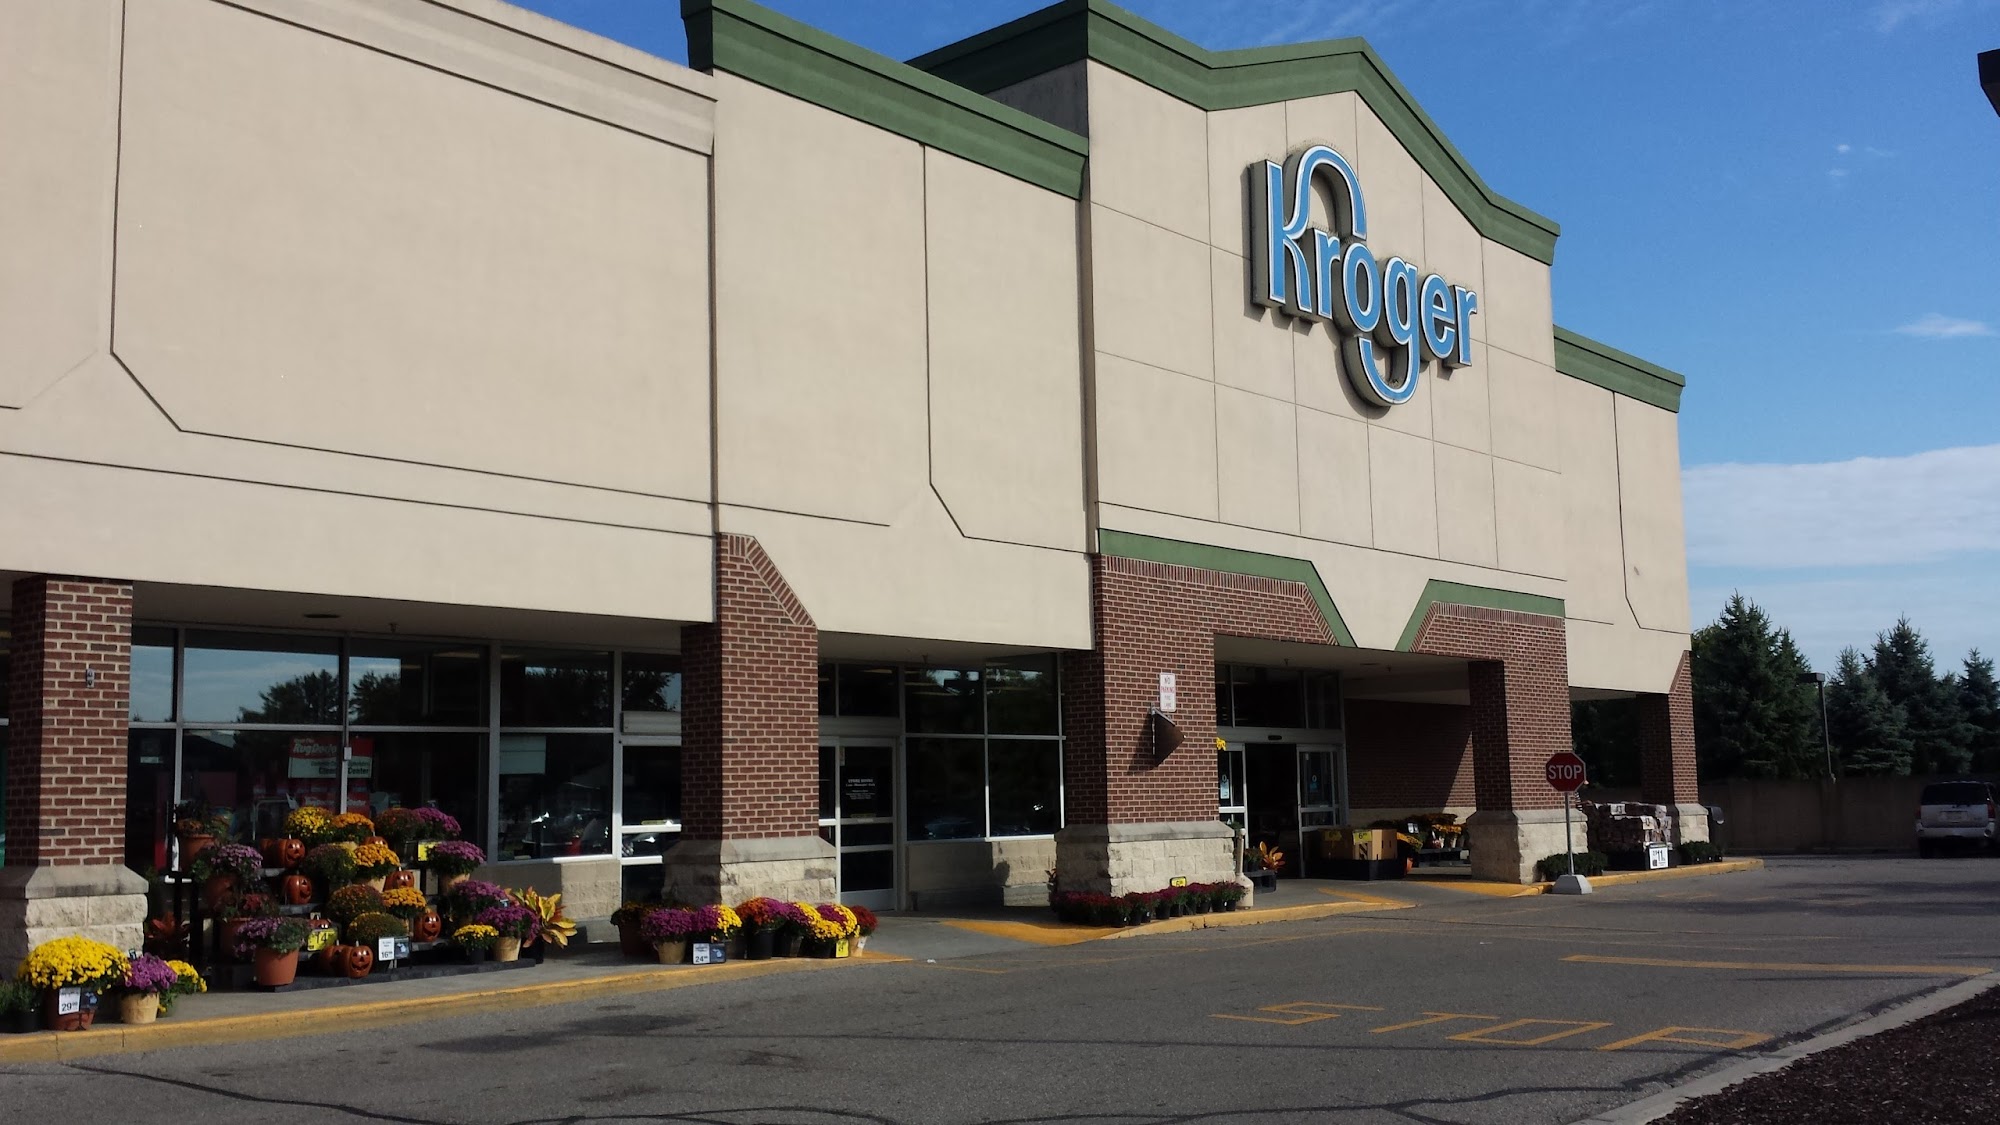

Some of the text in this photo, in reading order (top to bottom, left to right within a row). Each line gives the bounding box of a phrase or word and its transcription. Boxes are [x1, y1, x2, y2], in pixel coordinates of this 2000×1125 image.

[1264, 144, 1477, 405] Kroger
[1548, 765, 1582, 780] STOP
[1208, 1001, 1777, 1052] STOP
